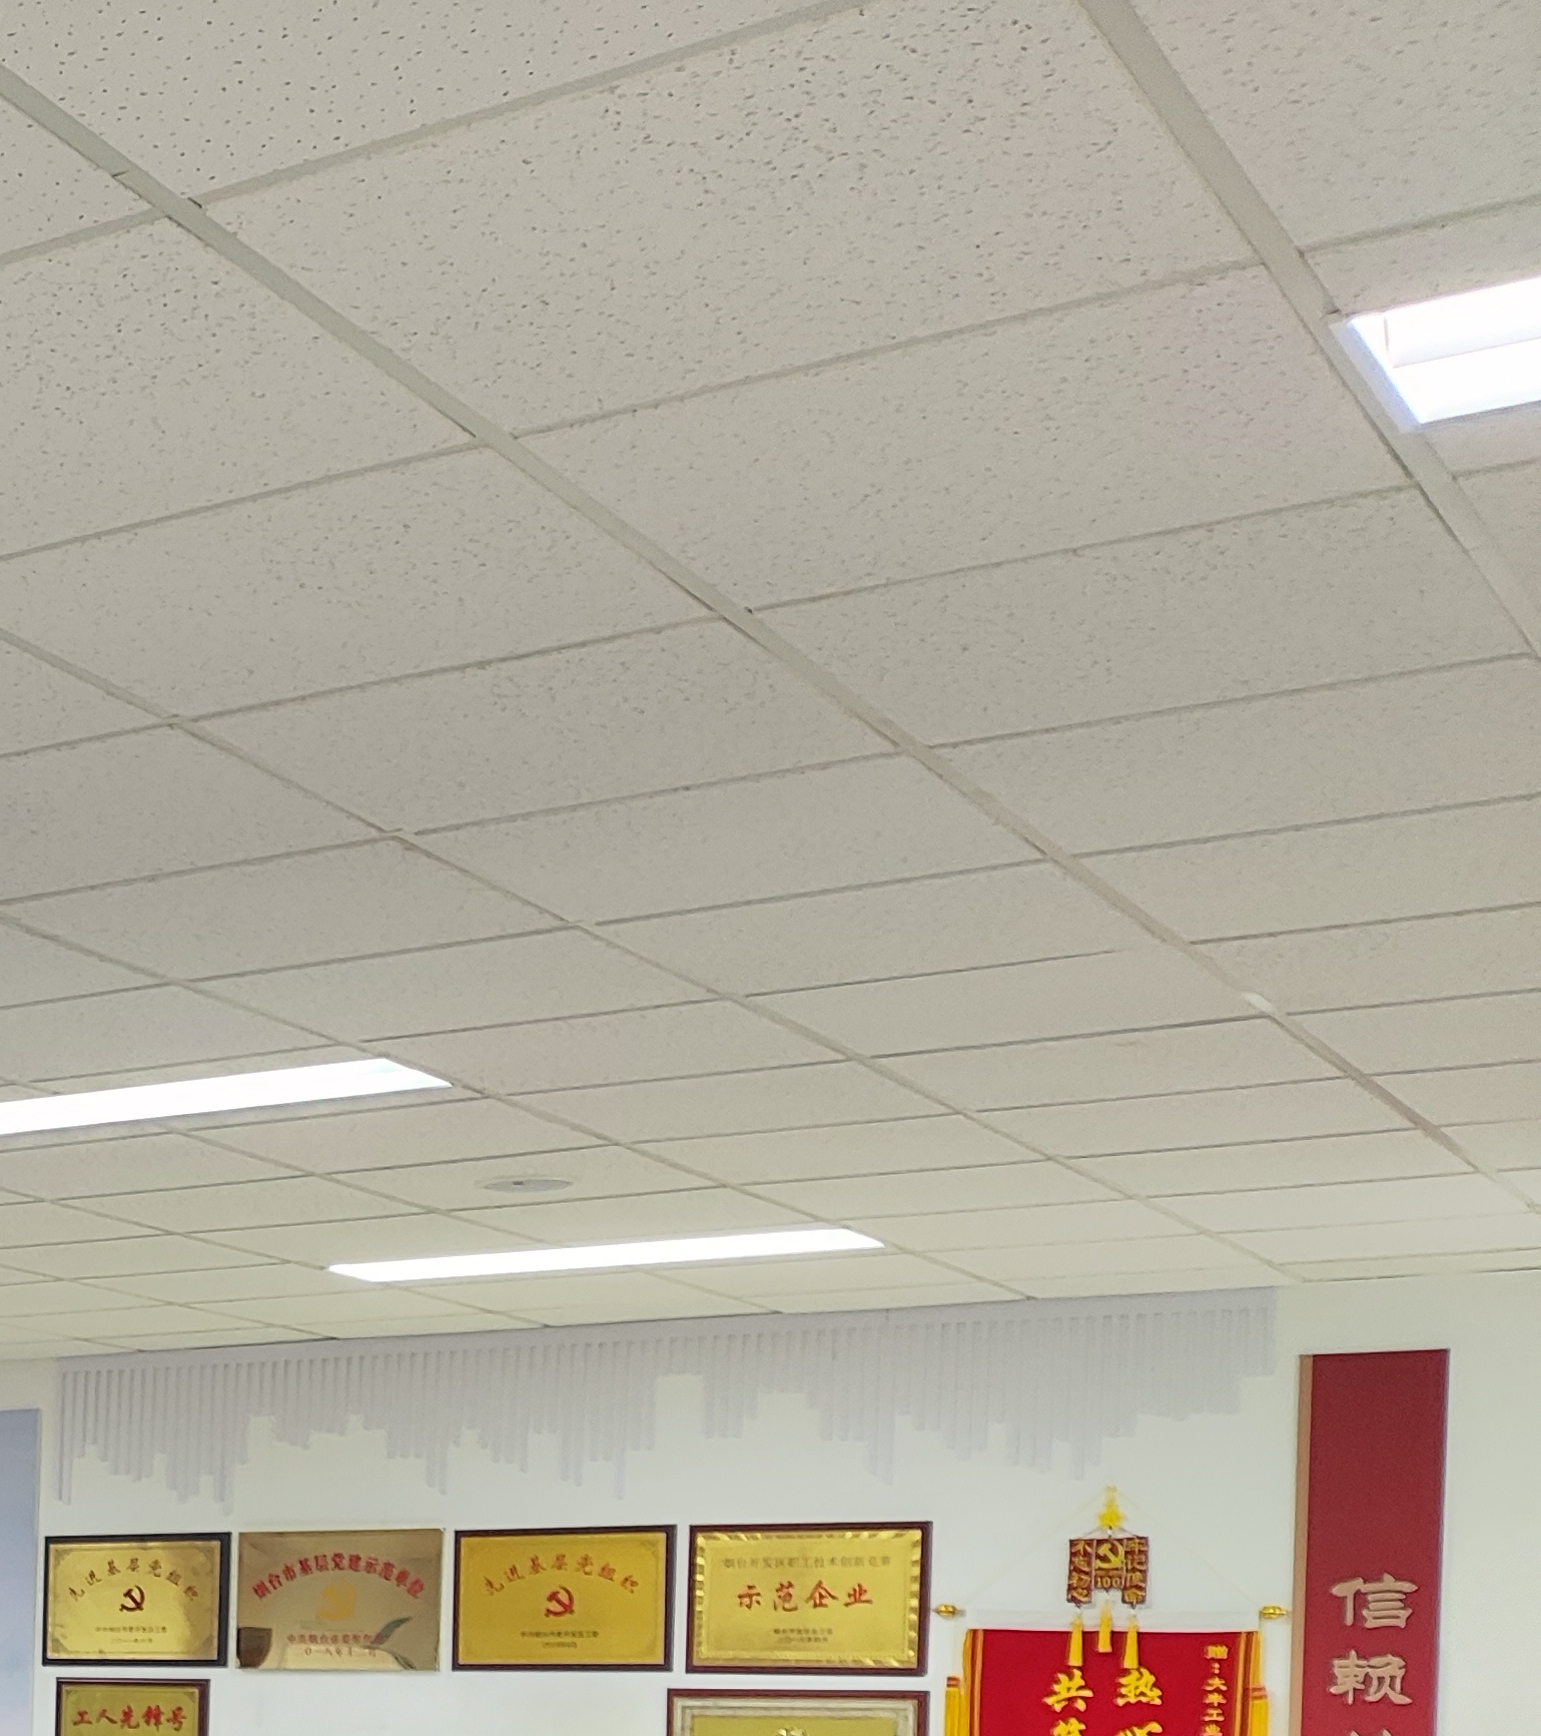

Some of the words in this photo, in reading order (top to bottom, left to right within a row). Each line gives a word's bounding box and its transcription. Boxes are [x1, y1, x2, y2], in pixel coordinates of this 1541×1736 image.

[1068, 1540, 1092, 1602] 不忘初心
[1096, 1576, 1122, 1589] 100
[1124, 1538, 1146, 1604] 牢记使命
[737, 1580, 873, 1612] 示范企业
[72, 1704, 187, 1732] 工人先锋号
